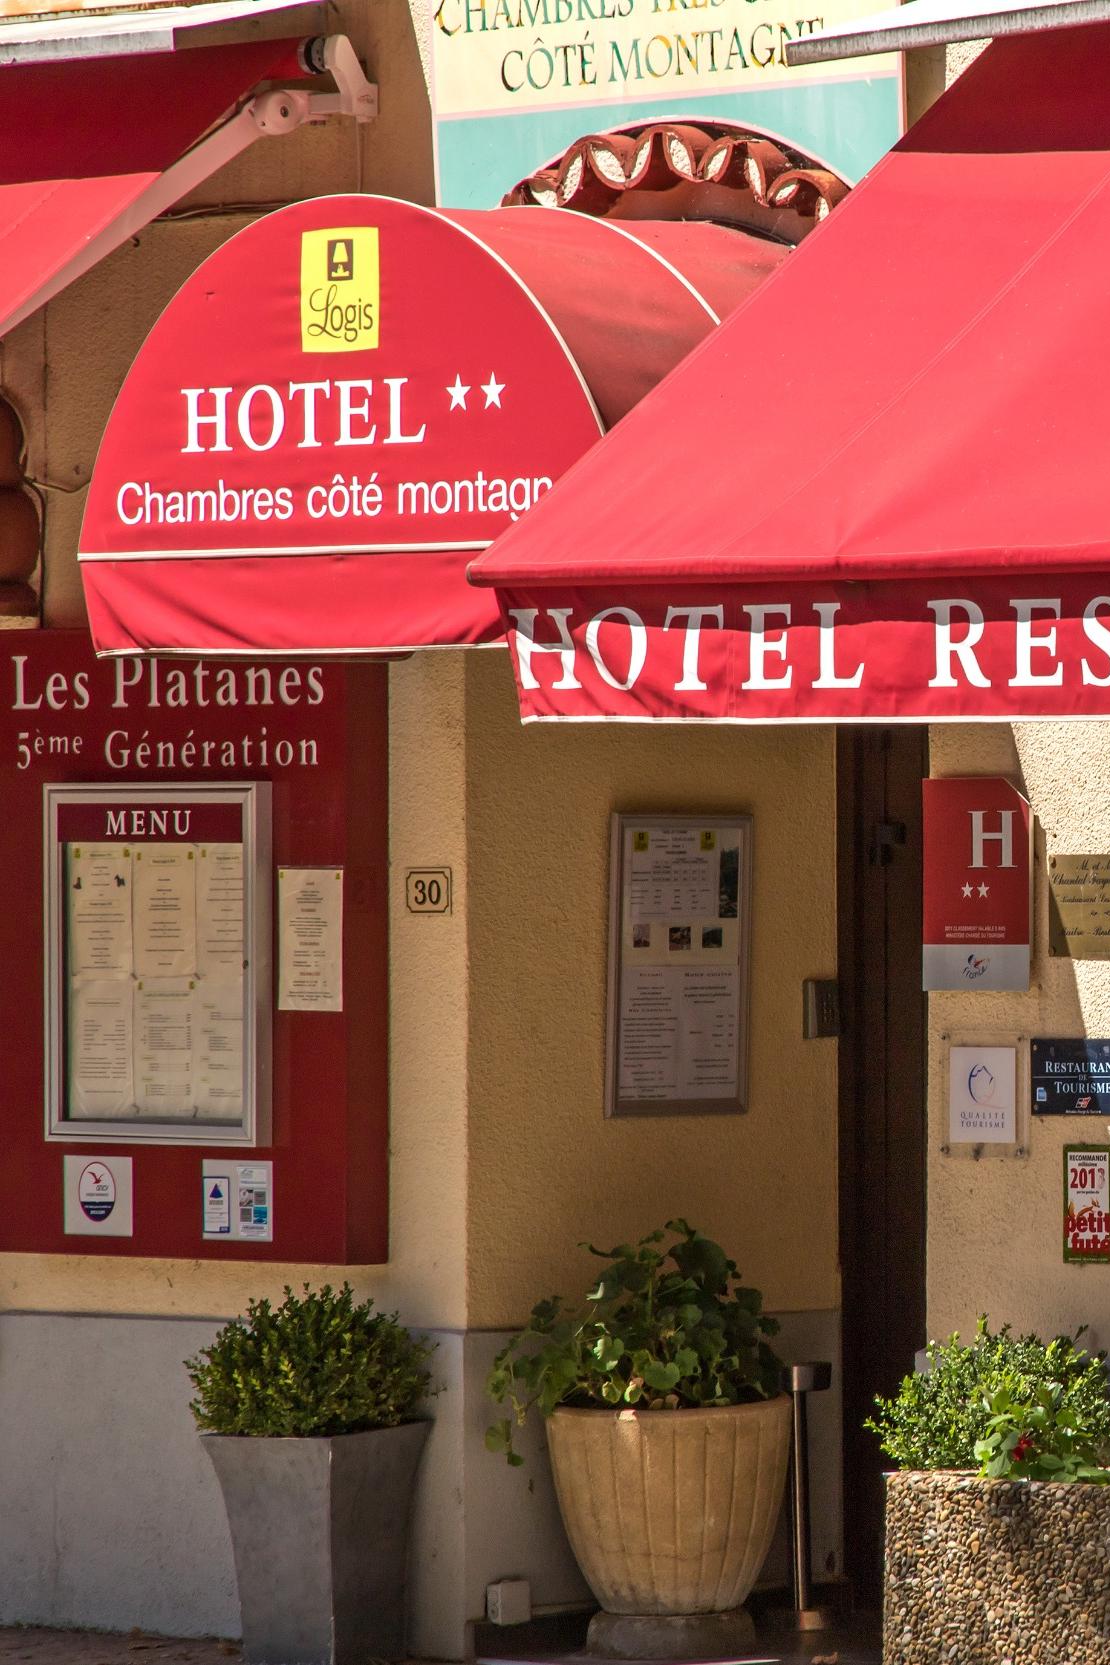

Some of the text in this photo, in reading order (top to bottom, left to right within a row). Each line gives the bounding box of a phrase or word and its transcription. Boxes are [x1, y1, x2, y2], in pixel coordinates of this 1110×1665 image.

[501, 30, 597, 92] CÔTÉ
[307, 284, 373, 342] Logis
[180, 377, 427, 453] HOTEL
[117, 481, 293, 525] Chambres
[307, 472, 383, 519] côté
[508, 602, 865, 691] HOTEL
[11, 655, 325, 710] Les Platanes
[16, 727, 319, 770] 5ème Génération
[105, 810, 191, 835] MENU
[967, 810, 1018, 868] H
[415, 880, 441, 905] 30
[960, 1120, 1005, 1128] TOURISME
